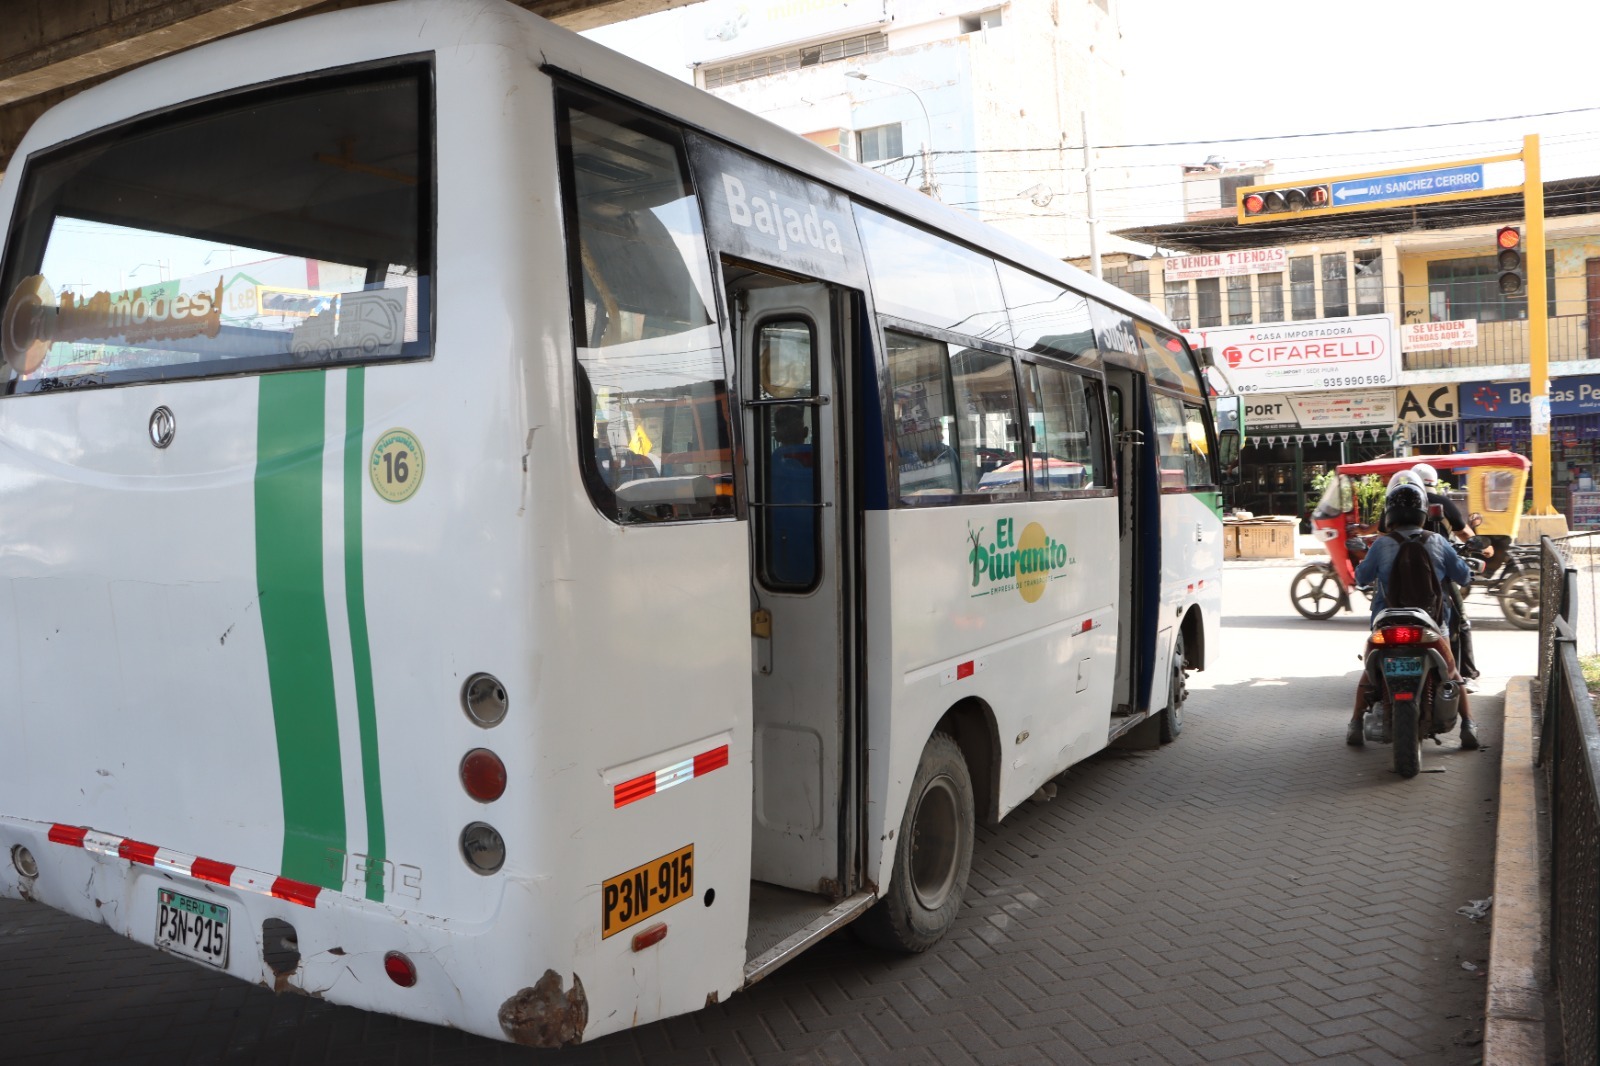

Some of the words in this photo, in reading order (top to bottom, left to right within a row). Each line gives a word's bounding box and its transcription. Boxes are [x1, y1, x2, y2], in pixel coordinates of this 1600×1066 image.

[1368, 185, 1384, 196] AV.
[1386, 178, 1433, 193] SANCHEZ
[1435, 172, 1480, 187] CERRRO
[721, 172, 844, 255] Bajada
[1166, 259, 1179, 271] SE
[1181, 255, 1222, 269] VENDEN
[1226, 249, 1283, 265] TIENDAS
[1256, 332, 1282, 341] CASA
[1284, 327, 1353, 339] IMPORTADORA
[1408, 333, 1440, 343] TIENDAS
[1413, 324, 1425, 334] SE
[1427, 320, 1465, 333] VENDEN
[1248, 340, 1376, 363] CIFARELLI
[1323, 377, 1343, 387] 935
[1344, 376, 1365, 386] 990
[1366, 375, 1386, 385] 596
[1397, 385, 1453, 420] AG
[1510, 387, 1575, 405] Bocas
[383, 450, 409, 484] 16
[996, 517, 1015, 549] El
[969, 535, 1068, 587] Piuranito
[990, 585, 1014, 596] EMPRESA
[1015, 582, 1023, 590] DE
[604, 851, 692, 931] P3N-915
[179, 897, 205, 915] PERU
[159, 904, 224, 956] P3N-915
